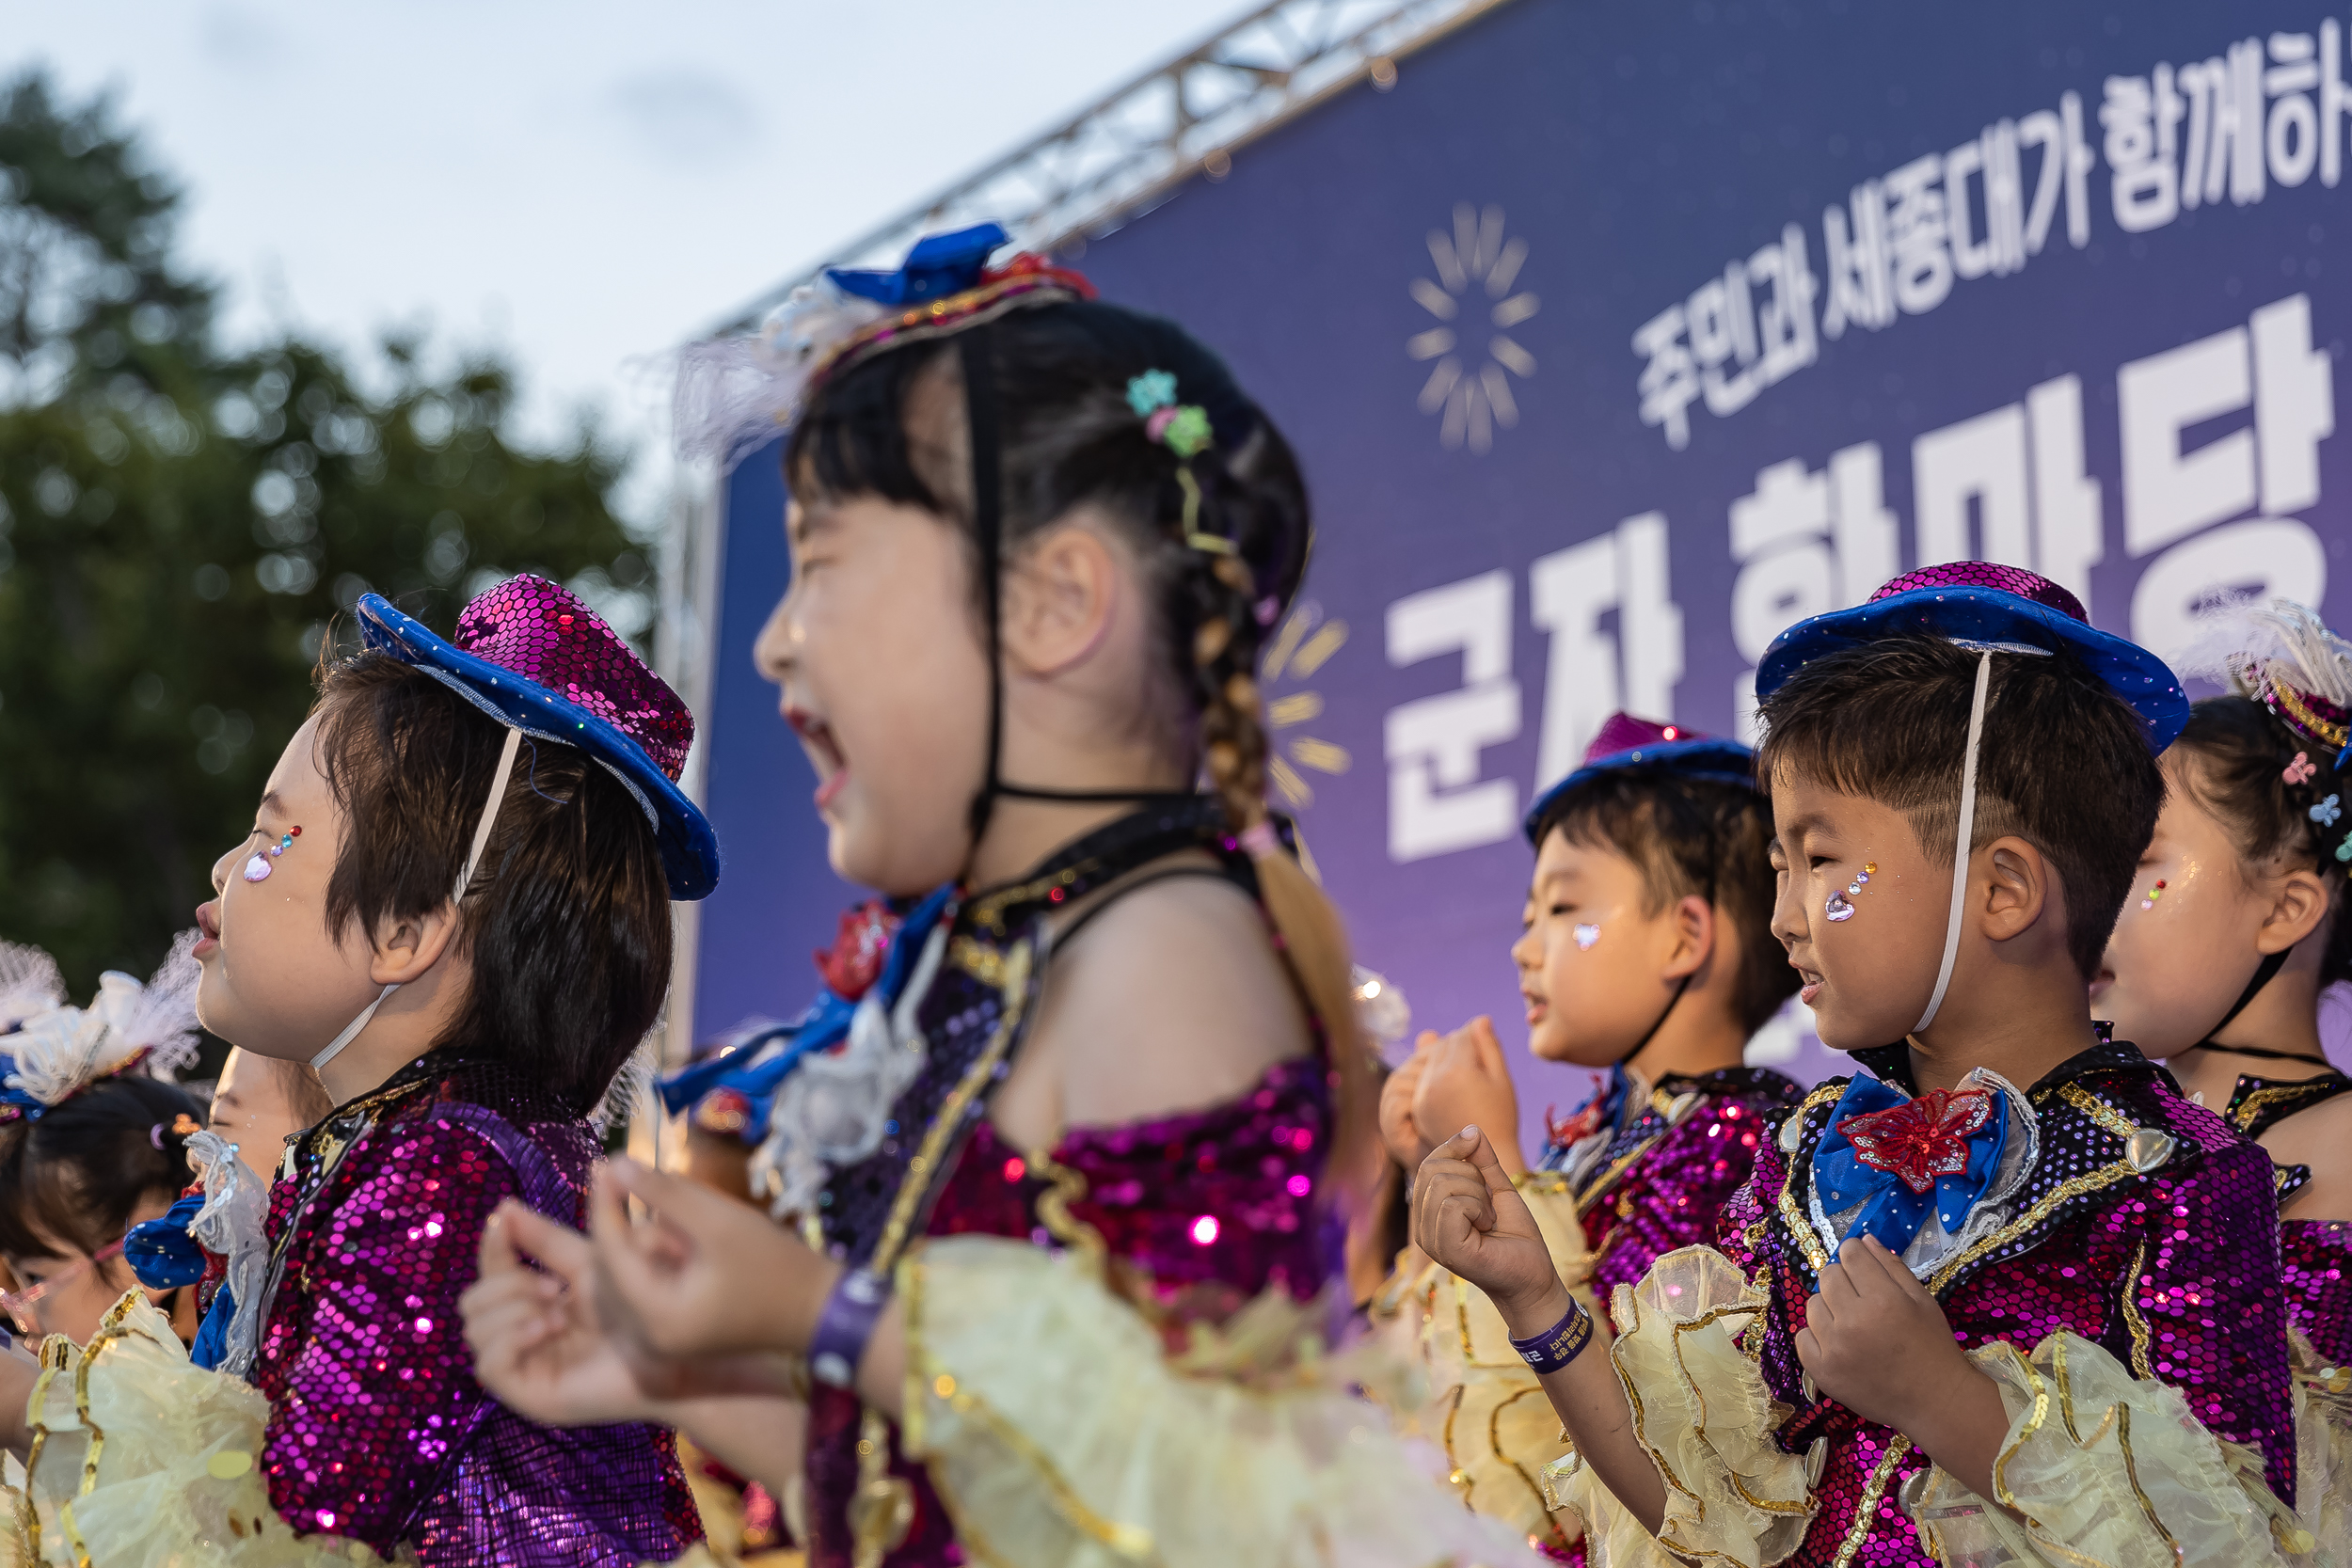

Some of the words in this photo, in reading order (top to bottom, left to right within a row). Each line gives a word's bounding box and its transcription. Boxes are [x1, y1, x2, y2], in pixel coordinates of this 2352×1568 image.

[1630, 221, 1819, 452] 주민과
[1821, 92, 2096, 341] 세종대가
[2097, 16, 2352, 233] 함께하
[1383, 509, 1686, 863] 군자
[1553, 1347, 1569, 1360] 경우
